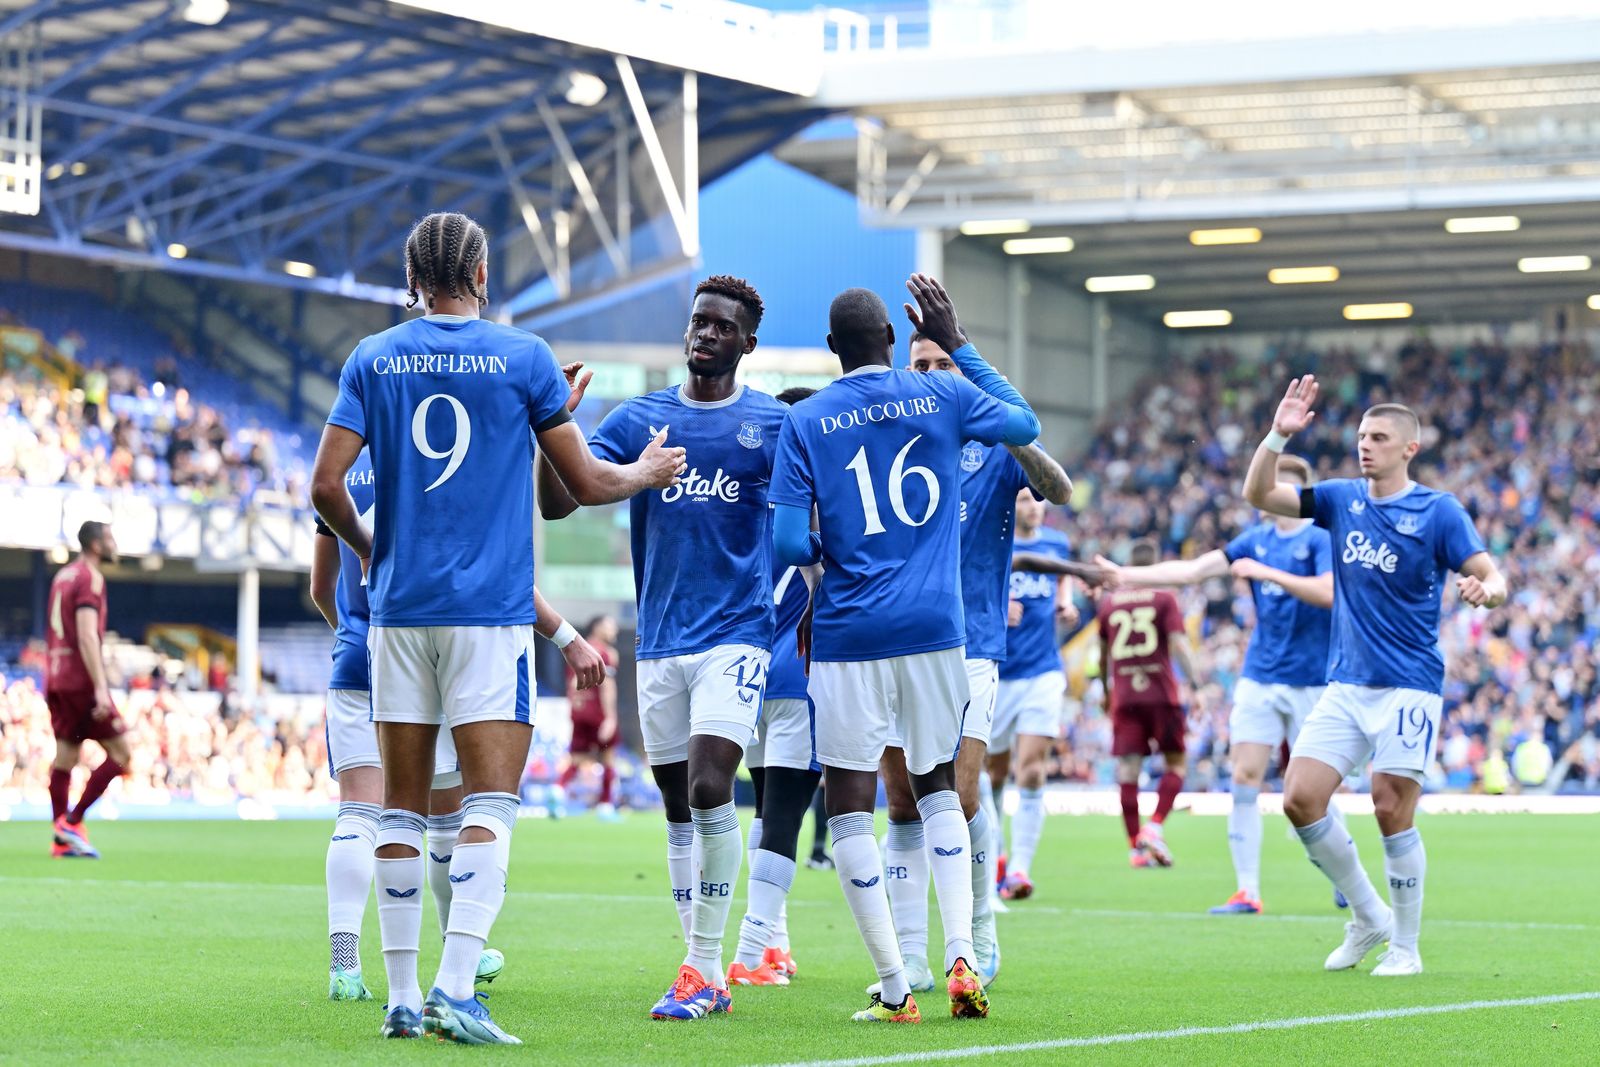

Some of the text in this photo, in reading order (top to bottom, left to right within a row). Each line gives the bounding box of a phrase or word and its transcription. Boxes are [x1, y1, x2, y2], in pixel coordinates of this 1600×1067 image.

[372, 354, 508, 376] CALVERT-LEWIN
[820, 395, 939, 434] DOUCOURE
[411, 393, 471, 493] 9
[661, 467, 740, 503] Stake
[844, 434, 941, 536] 16
[1342, 530, 1399, 573] Stake
[1108, 605, 1158, 661] 23
[722, 655, 761, 692] 42
[1396, 706, 1427, 737] 19
[700, 880, 729, 897] EFC
[1390, 877, 1417, 890] EFC
